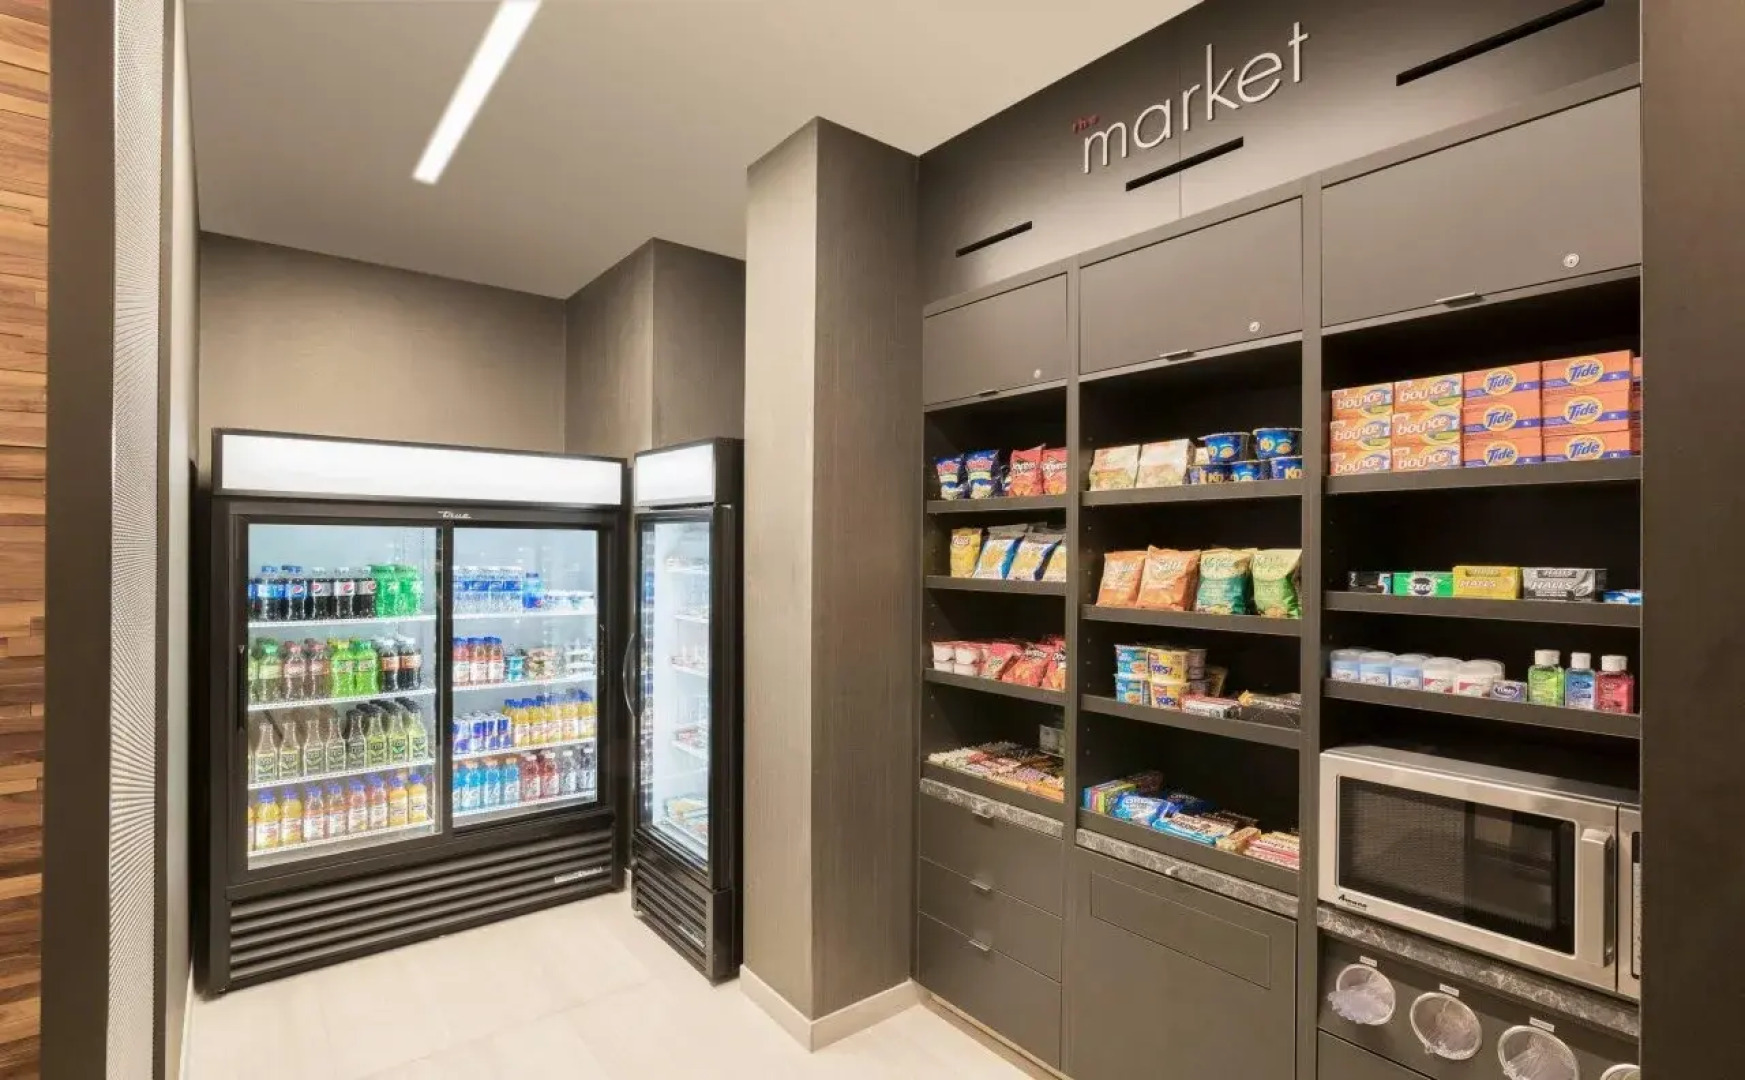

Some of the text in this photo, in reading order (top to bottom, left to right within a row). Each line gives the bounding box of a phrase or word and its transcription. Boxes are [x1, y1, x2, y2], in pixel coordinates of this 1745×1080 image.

[1083, 21, 1309, 174] market
[1569, 363, 1600, 381] Tide
[1487, 375, 1514, 390] Tide
[1487, 411, 1514, 427] Tide
[1568, 403, 1599, 420] Tide
[1488, 448, 1514, 463] Tide
[1569, 442, 1600, 459] Tide
